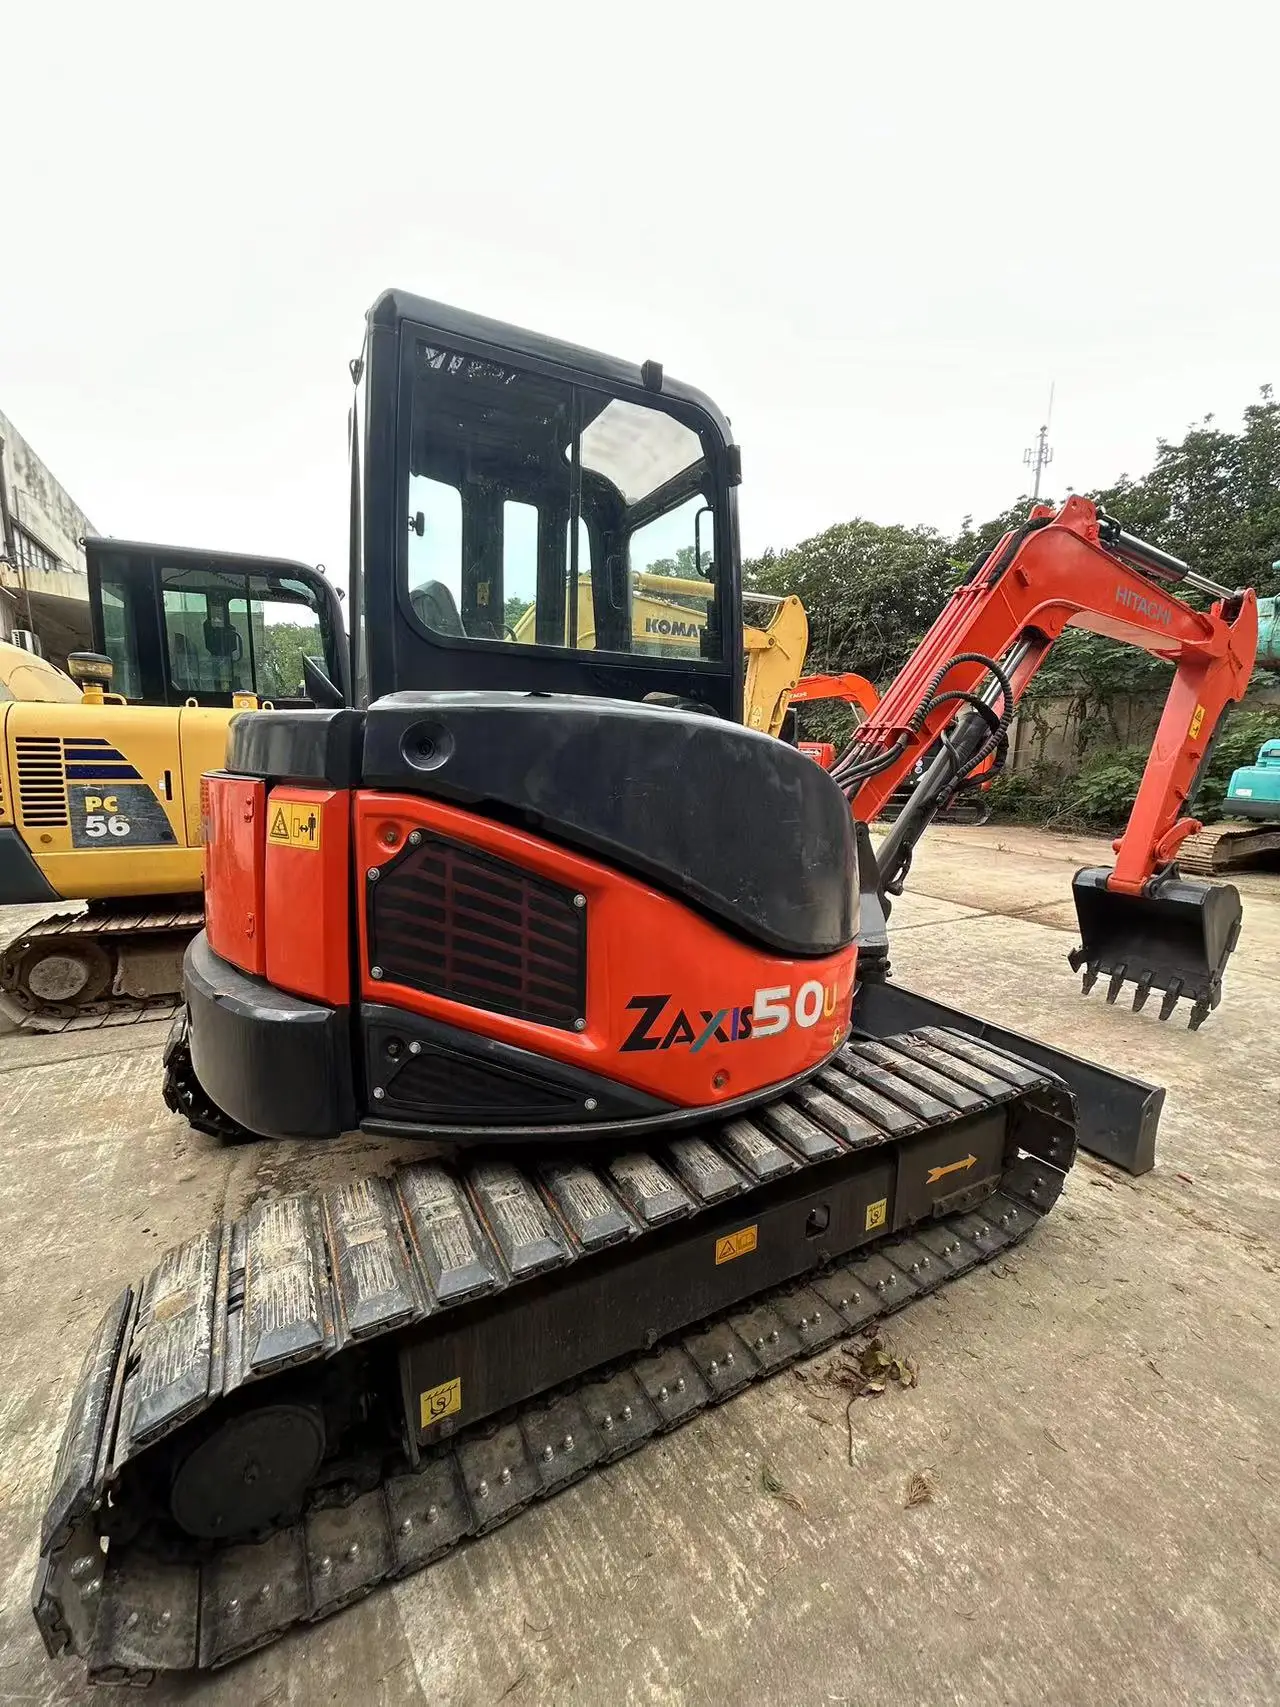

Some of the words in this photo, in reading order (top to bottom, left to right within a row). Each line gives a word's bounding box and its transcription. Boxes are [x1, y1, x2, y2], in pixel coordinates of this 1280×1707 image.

[1115, 585, 1174, 625] HITACHI
[85, 796, 118, 812] PC
[85, 814, 131, 837] 56
[619, 993, 753, 1053] ZAXIS
